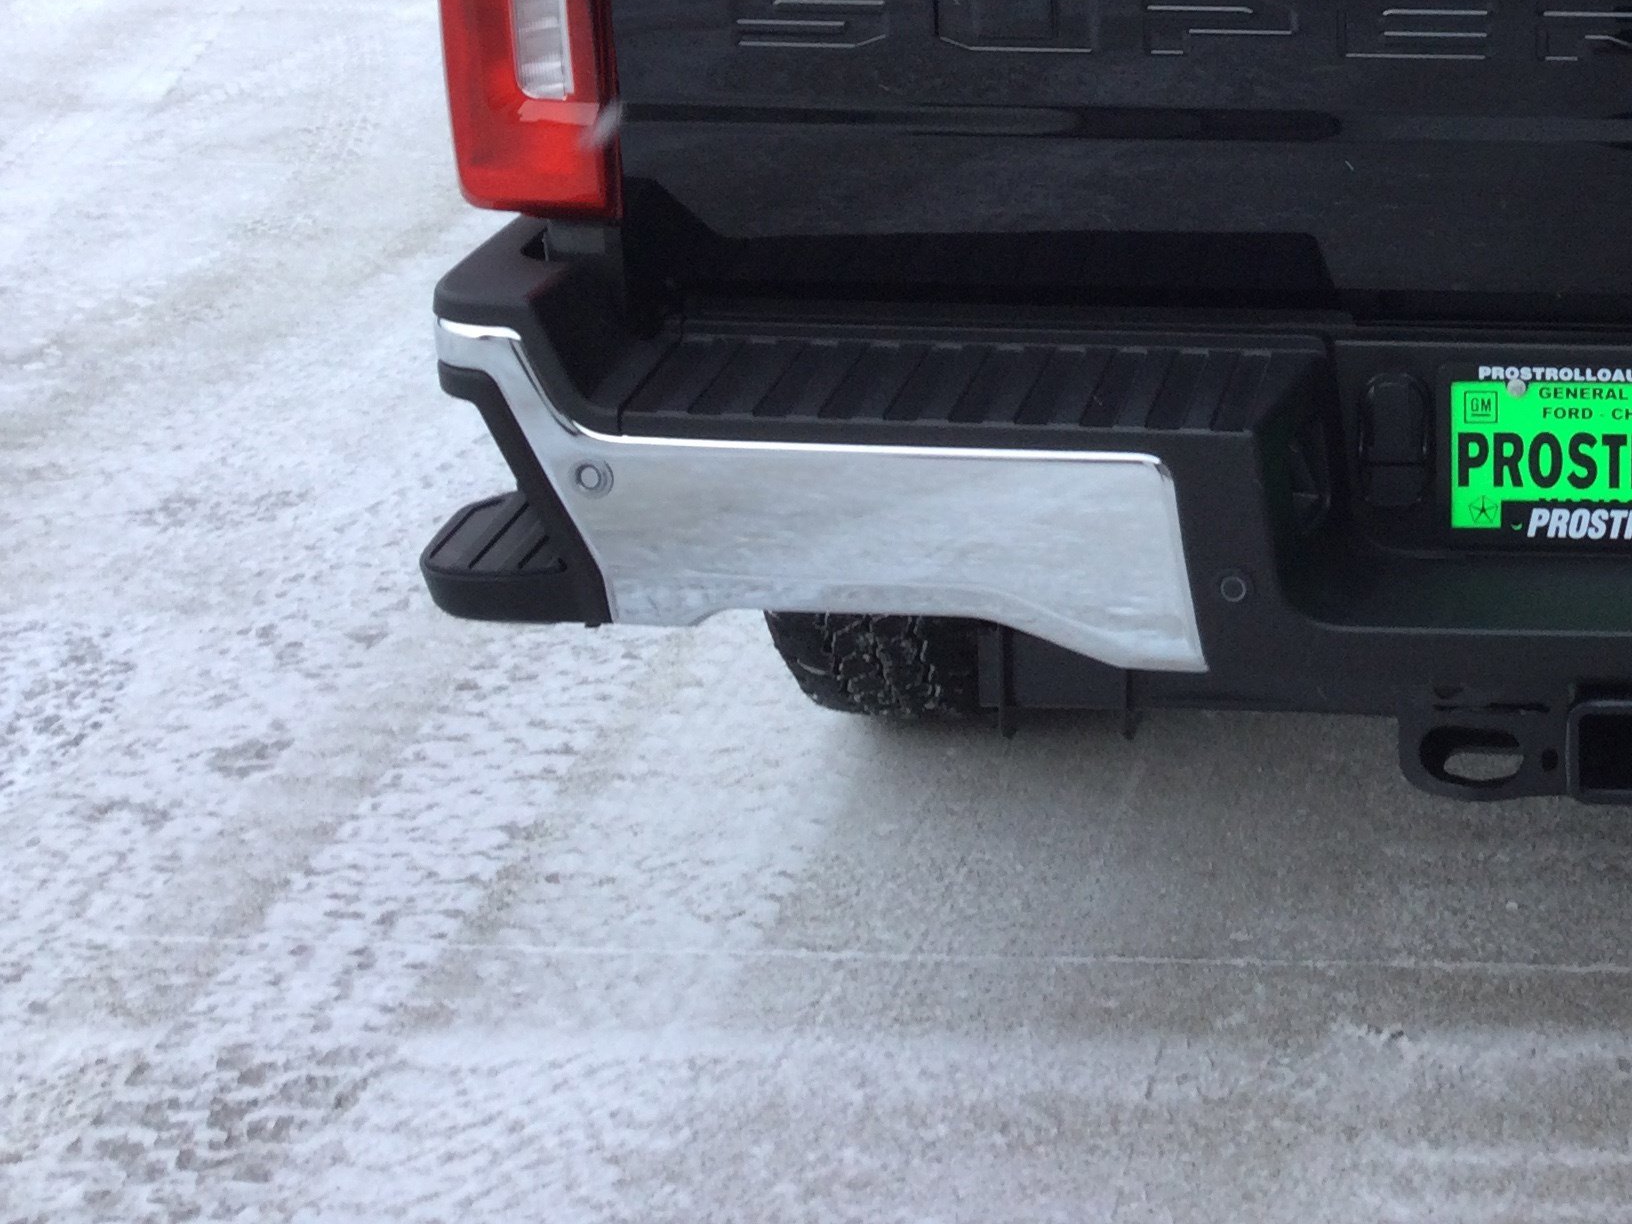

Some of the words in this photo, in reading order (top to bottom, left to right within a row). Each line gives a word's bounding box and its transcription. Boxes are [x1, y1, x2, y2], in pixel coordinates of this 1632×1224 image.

[1538, 386, 1629, 400] GENERAL
[1470, 399, 1492, 413] GM
[1542, 406, 1594, 420] FORD
